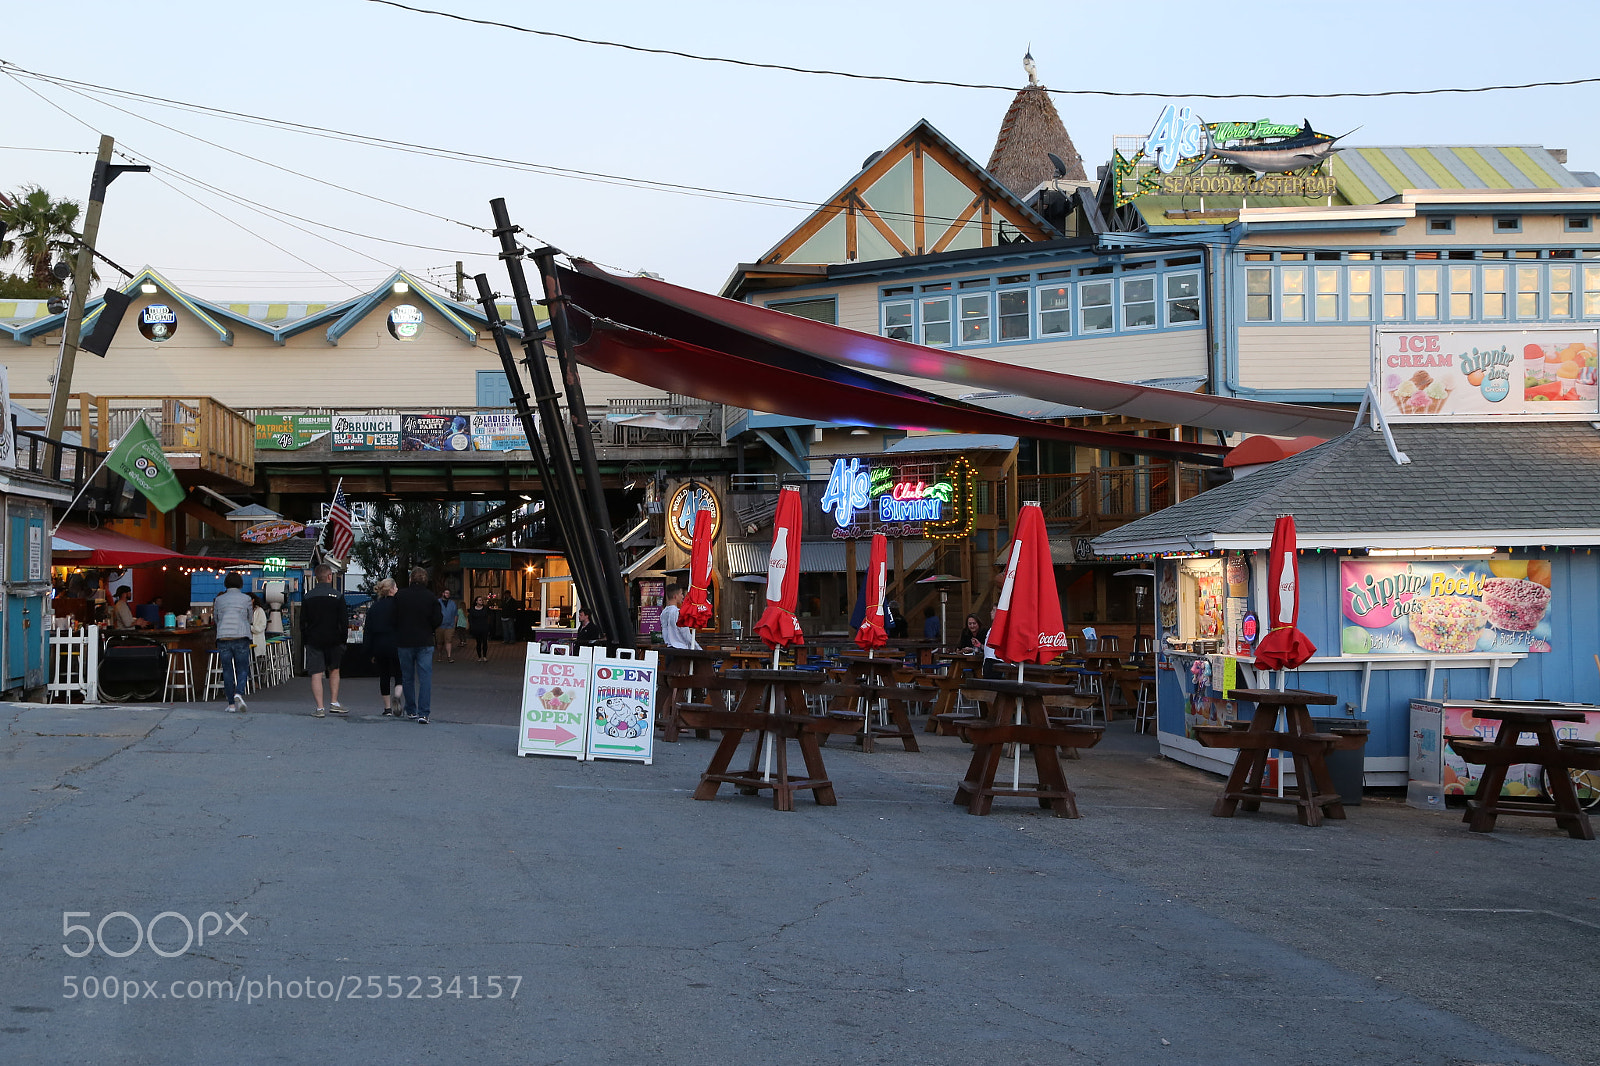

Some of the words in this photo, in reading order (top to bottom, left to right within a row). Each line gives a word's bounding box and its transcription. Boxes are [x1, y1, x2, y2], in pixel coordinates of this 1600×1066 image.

[1215, 125, 1250, 142] World
[1254, 118, 1299, 138] Famous
[1163, 176, 1232, 194] SEAFOOD
[1232, 176, 1246, 194] &
[1247, 176, 1304, 194] OYSTER
[1306, 174, 1337, 194] BAR
[1398, 335, 1440, 353] ICE
[1387, 354, 1453, 369] CREAM
[1458, 345, 1514, 376] dippin'
[256, 424, 294, 433] PATRICKS
[348, 421, 392, 432] BRUNCH
[483, 415, 510, 423] LADIES
[256, 432, 273, 440] DAY
[119, 463, 152, 490] tripadvisor
[892, 481, 925, 501] Club
[673, 489, 689, 511] WORLD
[703, 489, 716, 518] FAMOUS
[879, 495, 942, 521] BIMINI
[263, 557, 287, 572] ATM
[1346, 564, 1427, 617] dippin'
[1429, 571, 1487, 598] Rock!
[1392, 598, 1422, 619] dots
[541, 663, 575, 677] ICE
[597, 667, 653, 683] OPEN
[529, 675, 586, 689] CREAM
[597, 685, 633, 704] ITALIAN
[634, 687, 650, 707] ICE
[526, 710, 583, 725] OPEN
